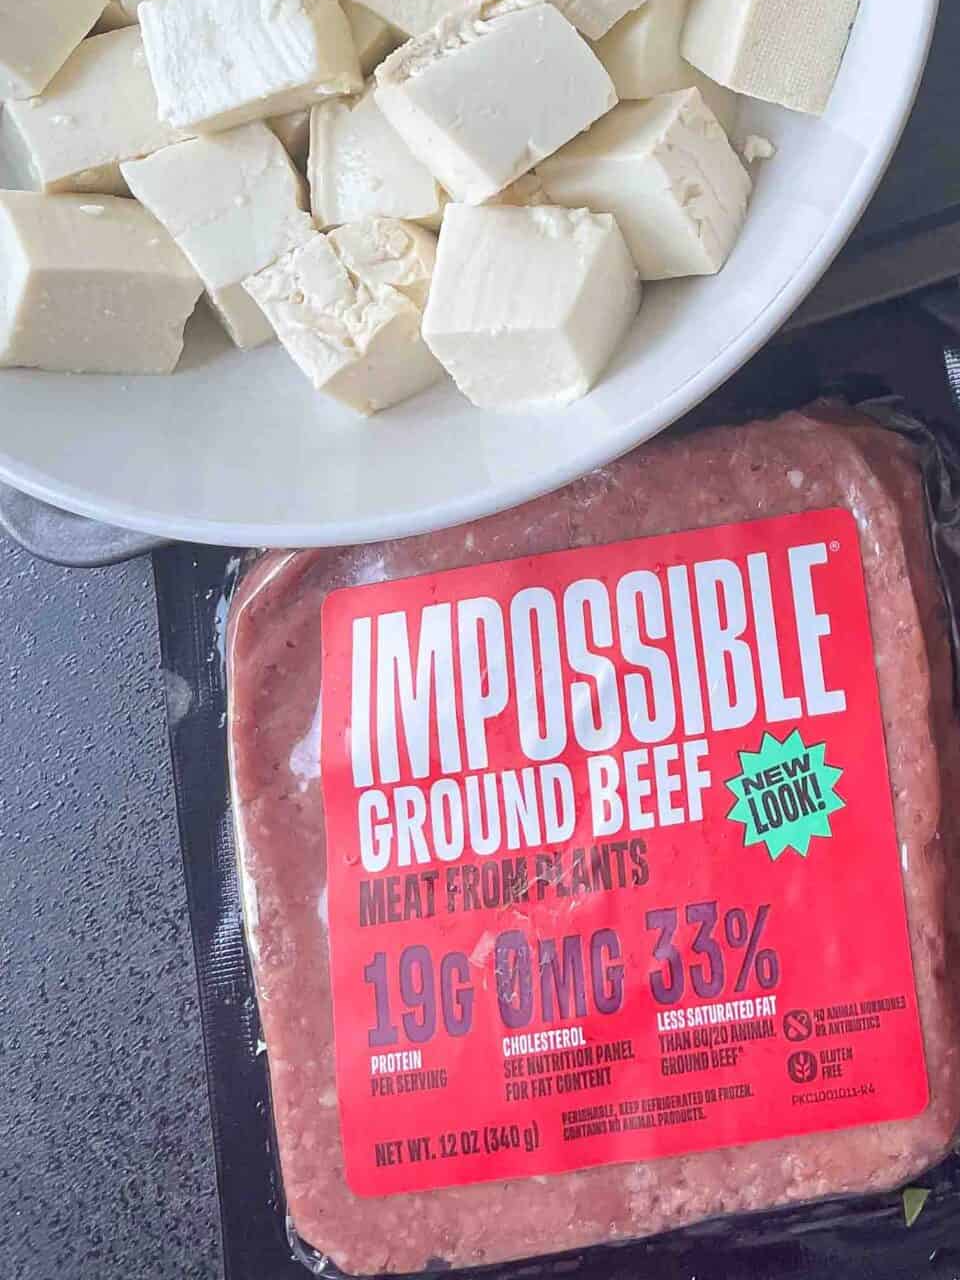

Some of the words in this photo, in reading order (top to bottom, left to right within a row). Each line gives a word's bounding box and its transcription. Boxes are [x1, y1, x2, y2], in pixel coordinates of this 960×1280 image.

[353, 542, 848, 788] IMPOSSIBLE
[741, 754, 811, 793] NEW
[358, 762, 576, 873] GROUND
[590, 740, 712, 839] BEEF
[747, 773, 829, 835] LOOK!
[358, 868, 440, 927] MEAT
[446, 852, 529, 912] FROM
[534, 838, 650, 900] PLANTS
[363, 944, 474, 1048] 19G
[495, 927, 625, 1029] 0MG
[645, 899, 780, 1006] 33%
[656, 1008, 686, 1032] LESS
[686, 999, 754, 1028] SATURATED
[755, 995, 777, 1018] FAT
[502, 1026, 587, 1057] CHOLESTEROL
[659, 1030, 692, 1054] THAN
[730, 1019, 777, 1043] ANIMAL
[371, 1049, 422, 1074] PROTEIN
[503, 1058, 524, 1079] SEE
[526, 1046, 593, 1075] NUTRITION
[595, 1039, 636, 1065] PANEL
[661, 1051, 709, 1077] GROUND
[819, 1047, 854, 1065] GLUTEN
[821, 1063, 843, 1080] FREE
[371, 1074, 395, 1097] PER
[396, 1068, 448, 1094] SERVING
[505, 1080, 530, 1102] FOR
[531, 1075, 554, 1099] FAT
[556, 1067, 612, 1095] CONTENT
[375, 1141, 404, 1167] NET
[407, 1135, 436, 1163] WT.
[438, 1134, 457, 1158] 12
[460, 1130, 480, 1155] OZ
[483, 1124, 521, 1155] (340
[523, 1119, 540, 1152] g)
